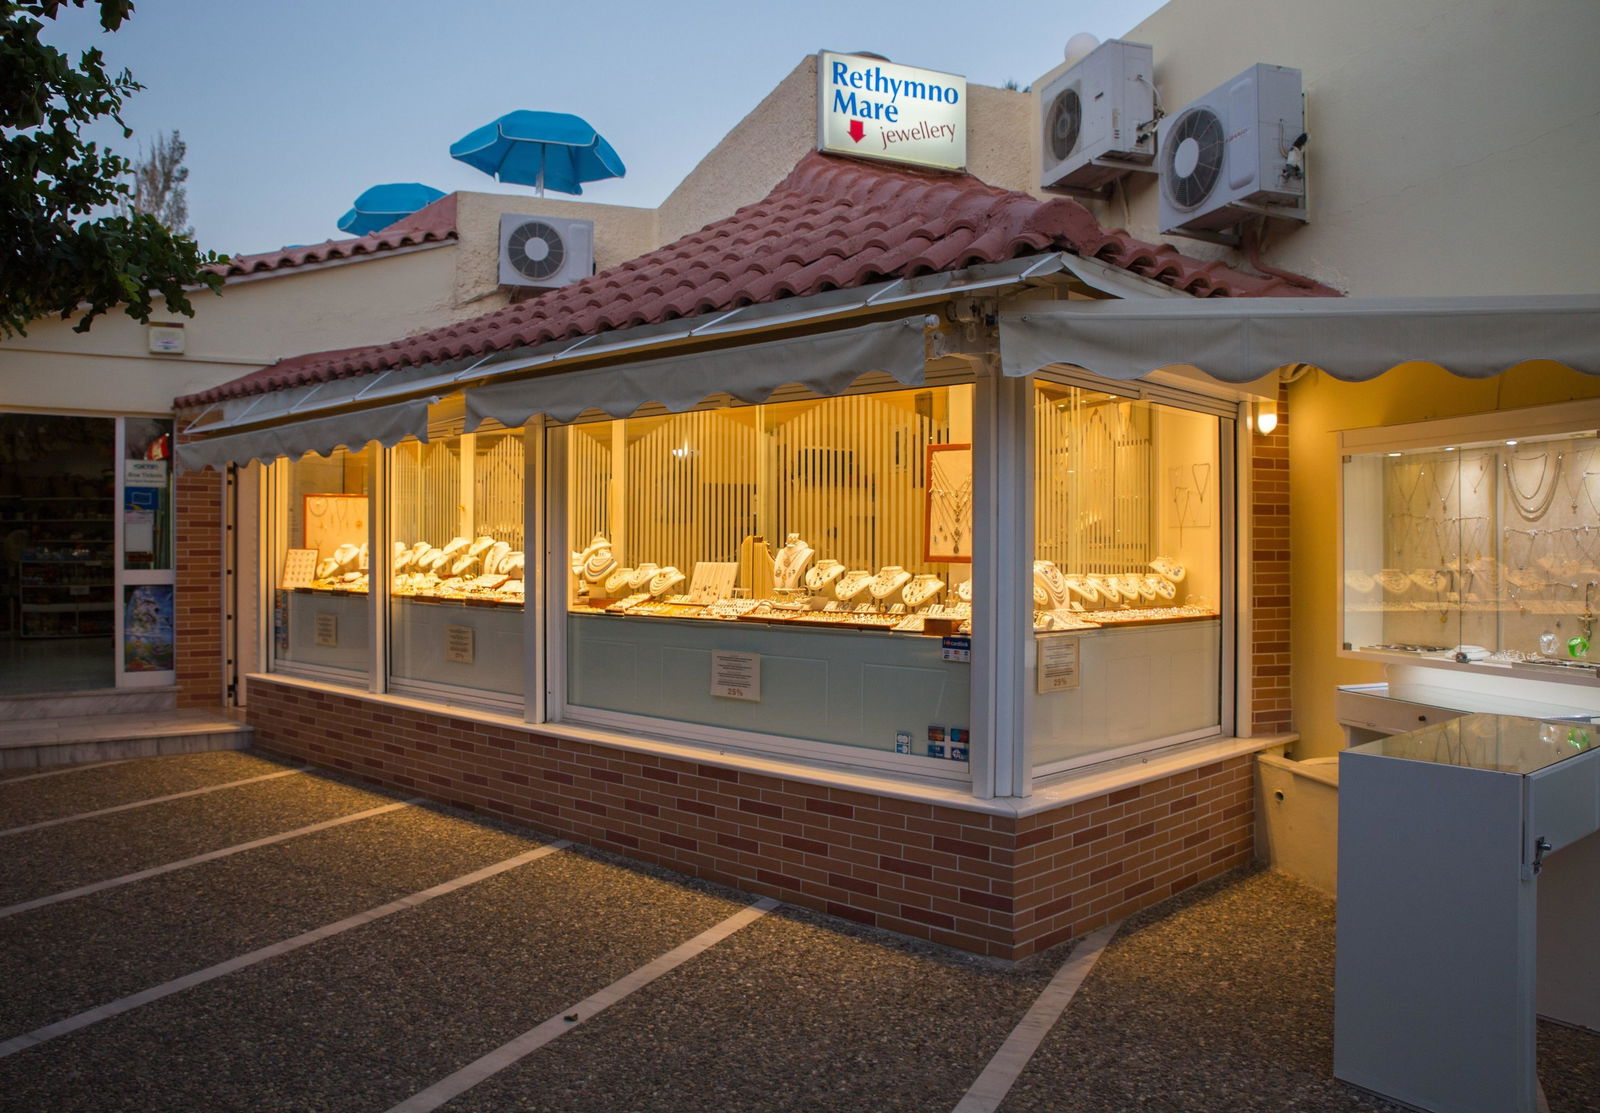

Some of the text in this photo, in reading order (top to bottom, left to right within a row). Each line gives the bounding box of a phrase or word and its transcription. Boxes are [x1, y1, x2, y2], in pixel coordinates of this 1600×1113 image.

[833, 61, 959, 105] Rethymno
[833, 89, 898, 123] Mare
[880, 121, 956, 151] jewellery
